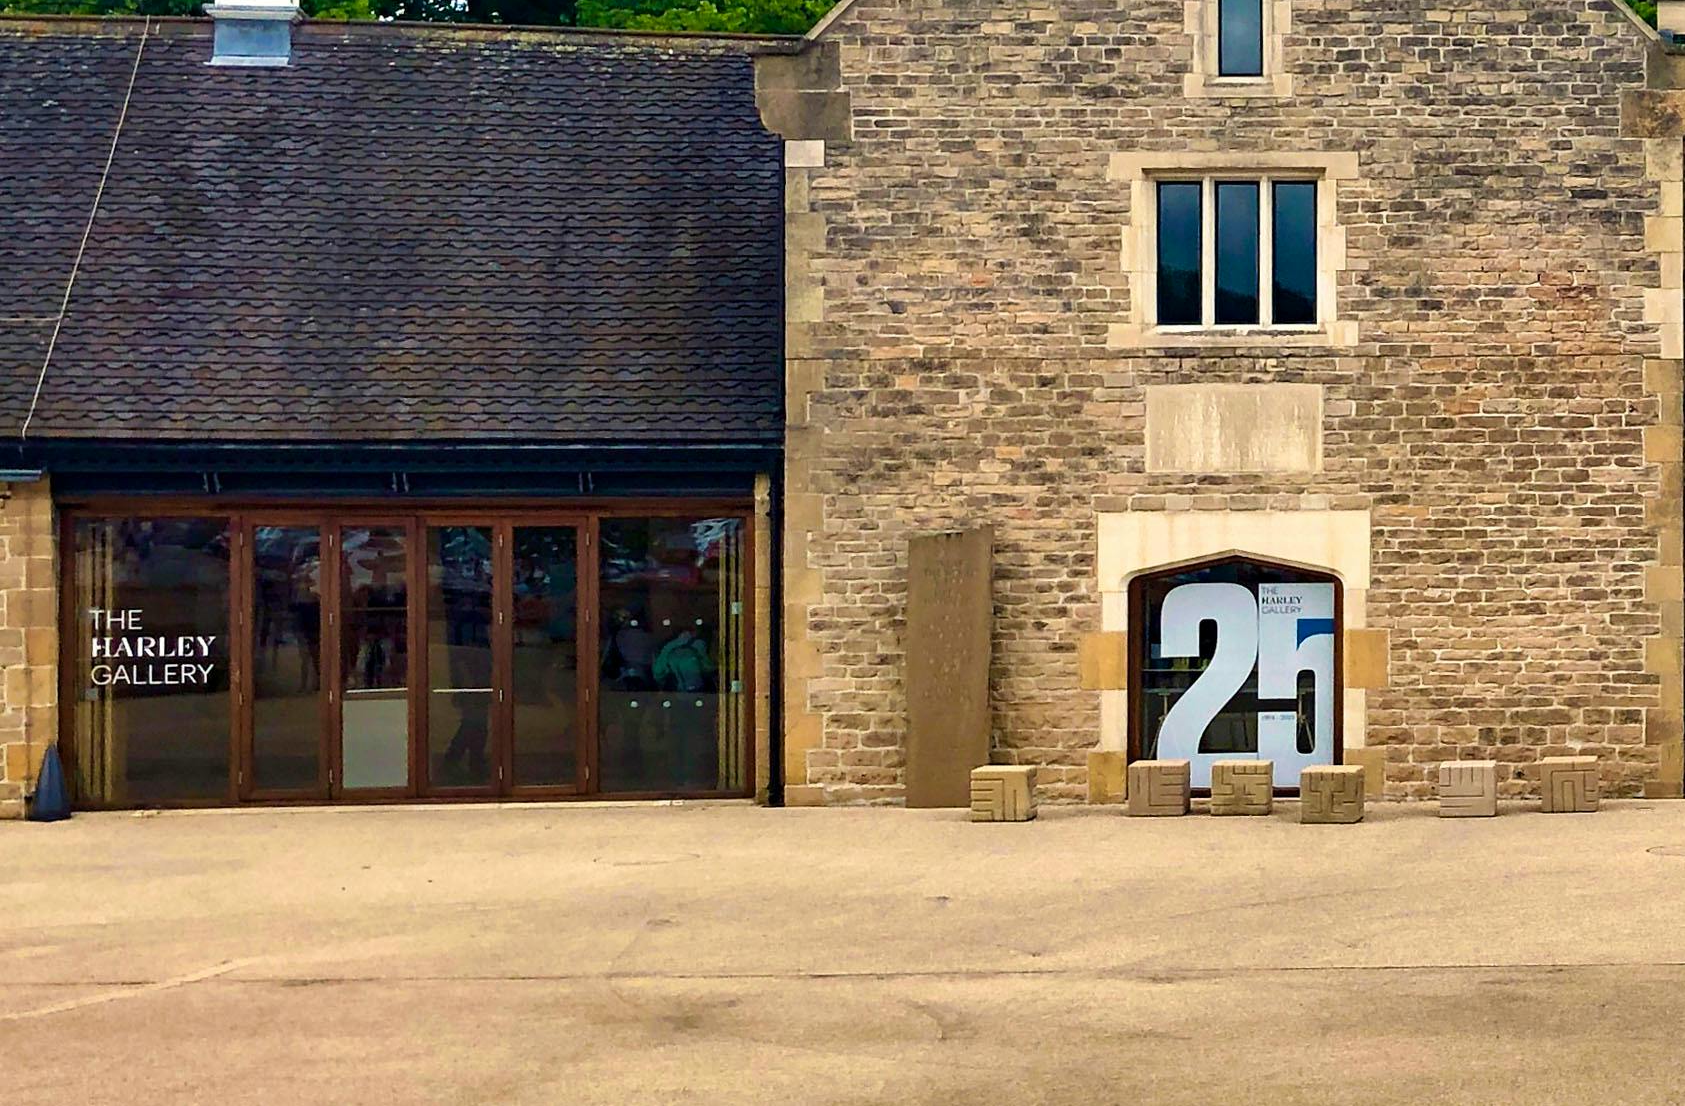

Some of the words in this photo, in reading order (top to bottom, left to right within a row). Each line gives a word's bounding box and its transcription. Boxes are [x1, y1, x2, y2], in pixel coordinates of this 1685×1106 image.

[1261, 586, 1279, 595] THE
[1262, 596, 1302, 605] HARLEY
[89, 609, 143, 630] THE
[1262, 605, 1302, 614] GALLERY
[92, 636, 216, 657] HARLEY
[91, 663, 214, 685] GALLERY
[1157, 583, 1335, 787] 25
